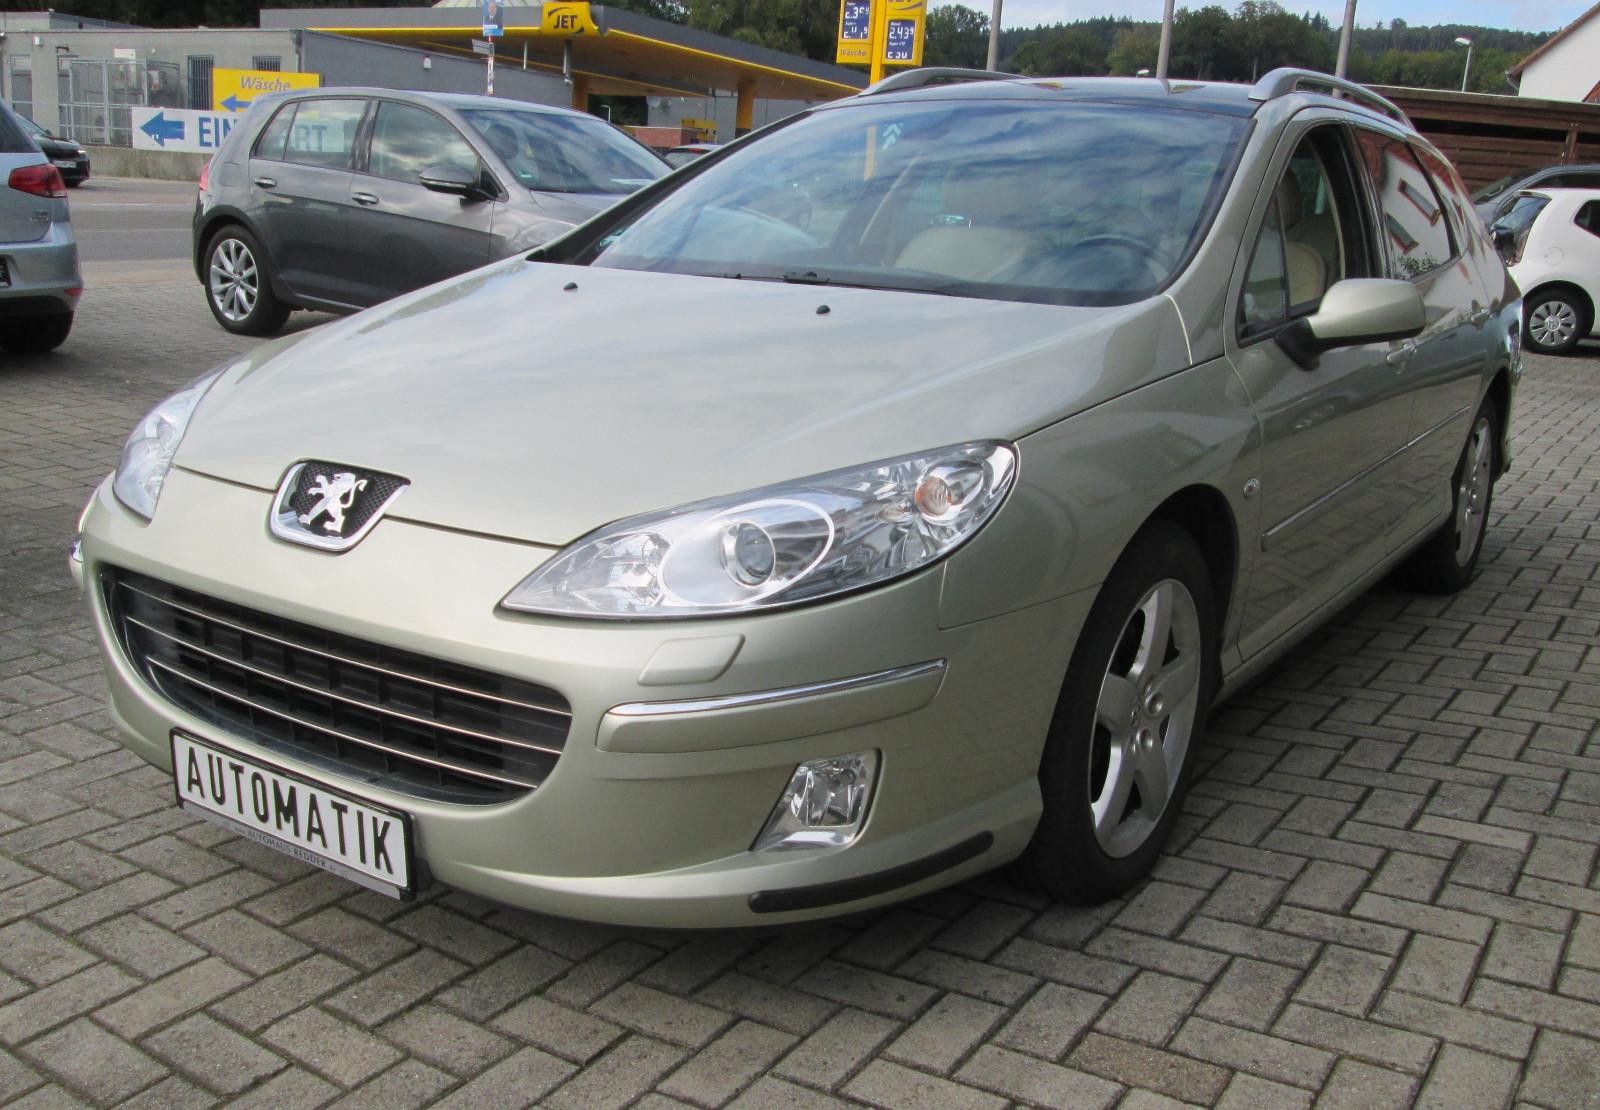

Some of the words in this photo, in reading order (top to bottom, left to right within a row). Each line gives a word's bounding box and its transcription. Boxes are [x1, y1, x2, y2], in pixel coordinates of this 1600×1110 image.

[553, 15, 578, 30] JET
[240, 76, 290, 92] Wäsche
[187, 746, 394, 875] AUTOMATIK
[247, 829, 291, 854] AUTOHAUS
